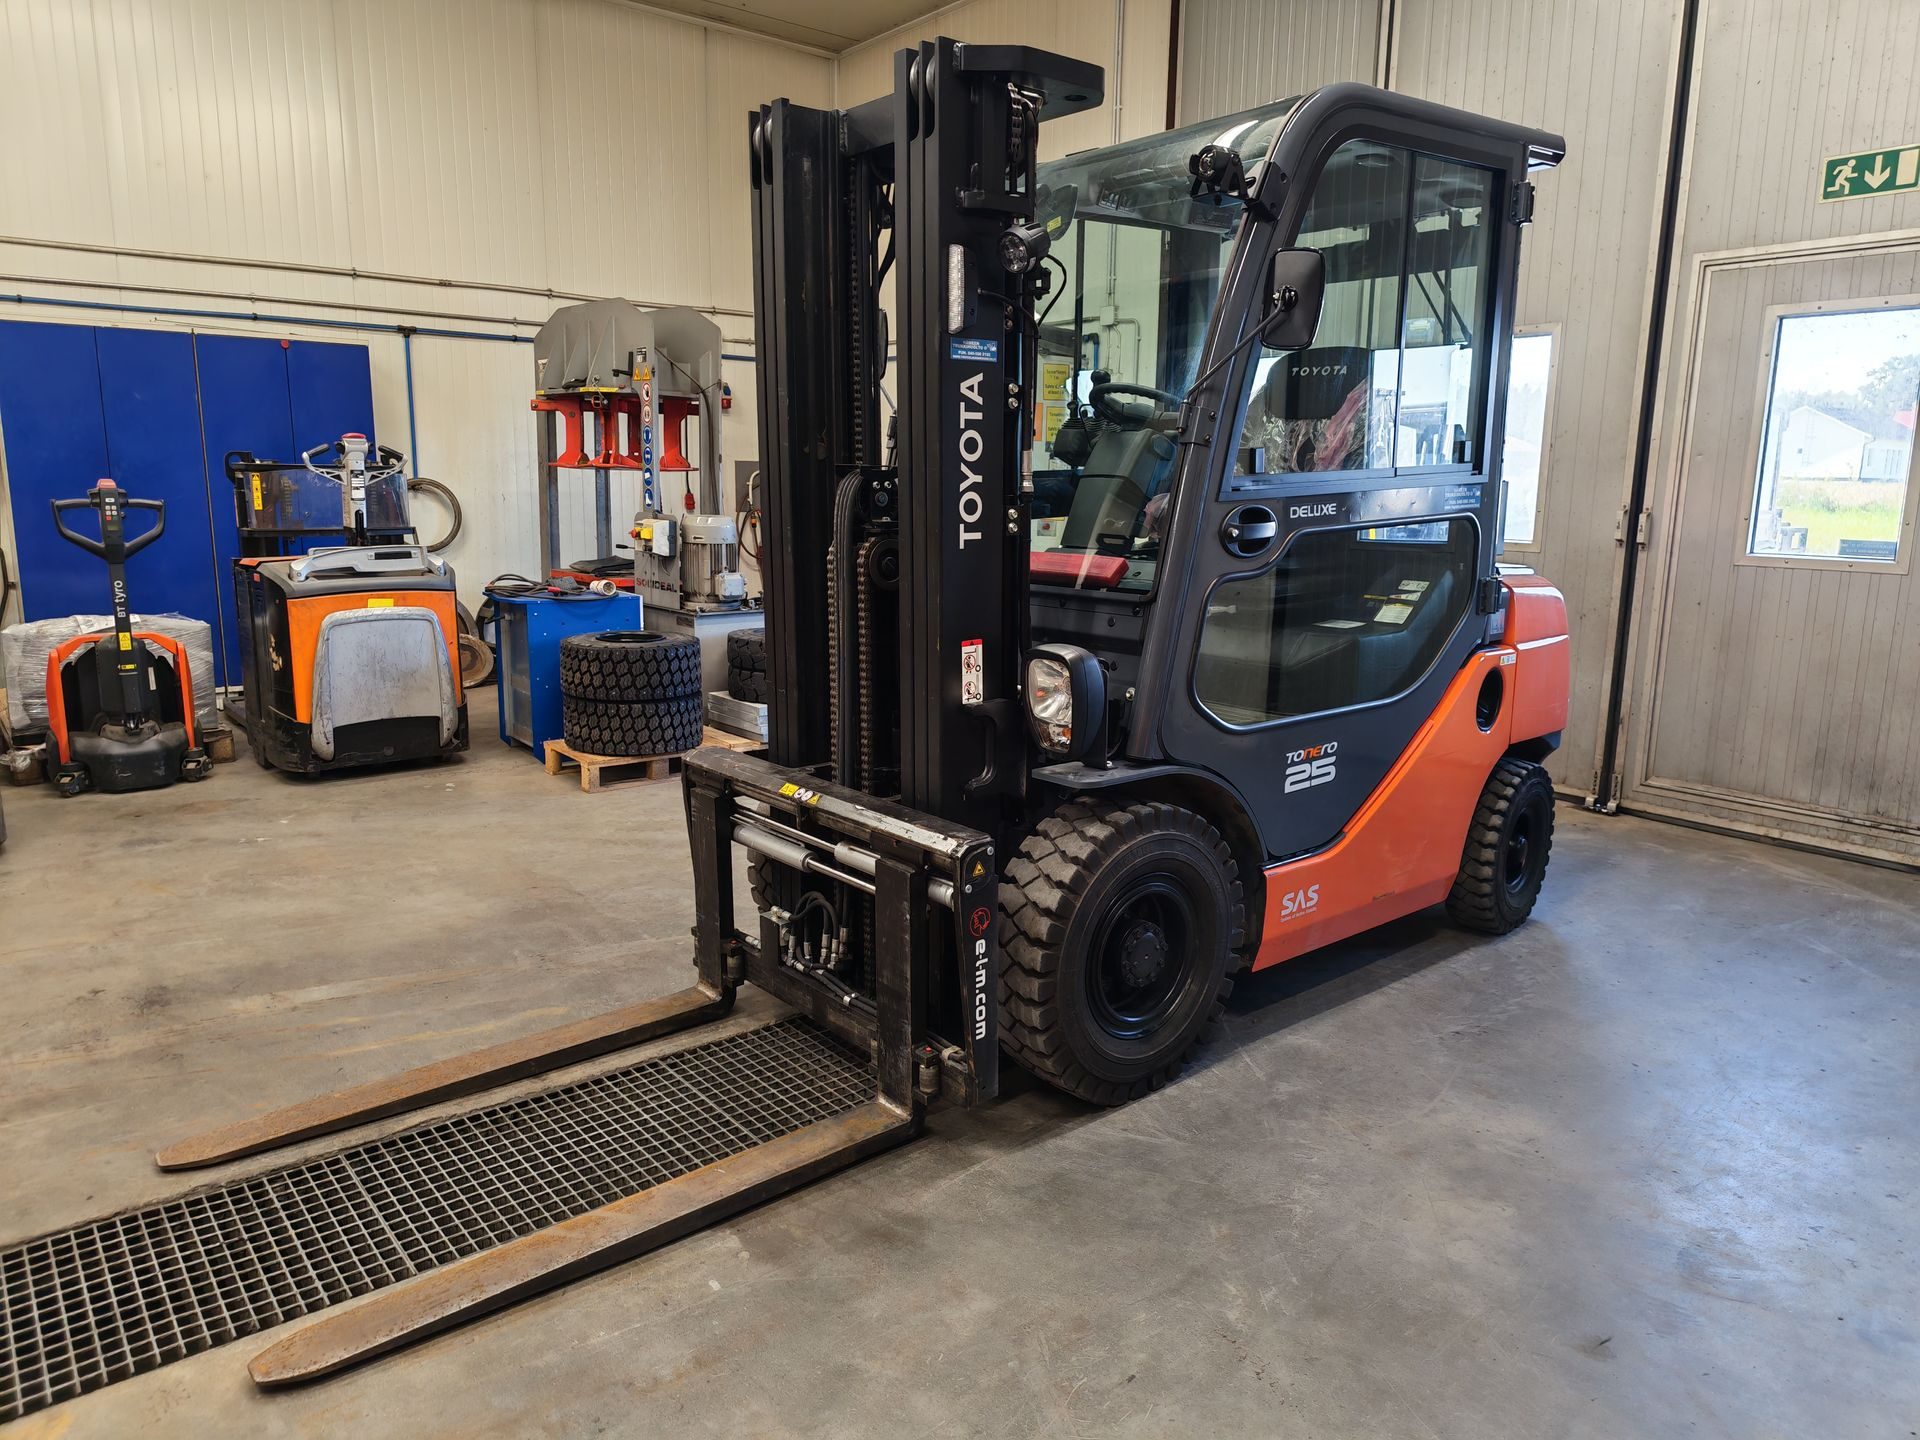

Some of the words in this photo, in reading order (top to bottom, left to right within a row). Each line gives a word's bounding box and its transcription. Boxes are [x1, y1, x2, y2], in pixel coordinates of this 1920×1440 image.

[1291, 365, 1347, 376] TOYOTA
[959, 372, 984, 550] TOYOTA
[1290, 503, 1337, 519] DELUXE
[114, 580, 127, 602] tyro
[117, 606, 126, 618] BT
[1284, 755, 1337, 794] 25
[1280, 884, 1320, 916] SAS
[975, 938, 989, 1041] e-l-m.com
